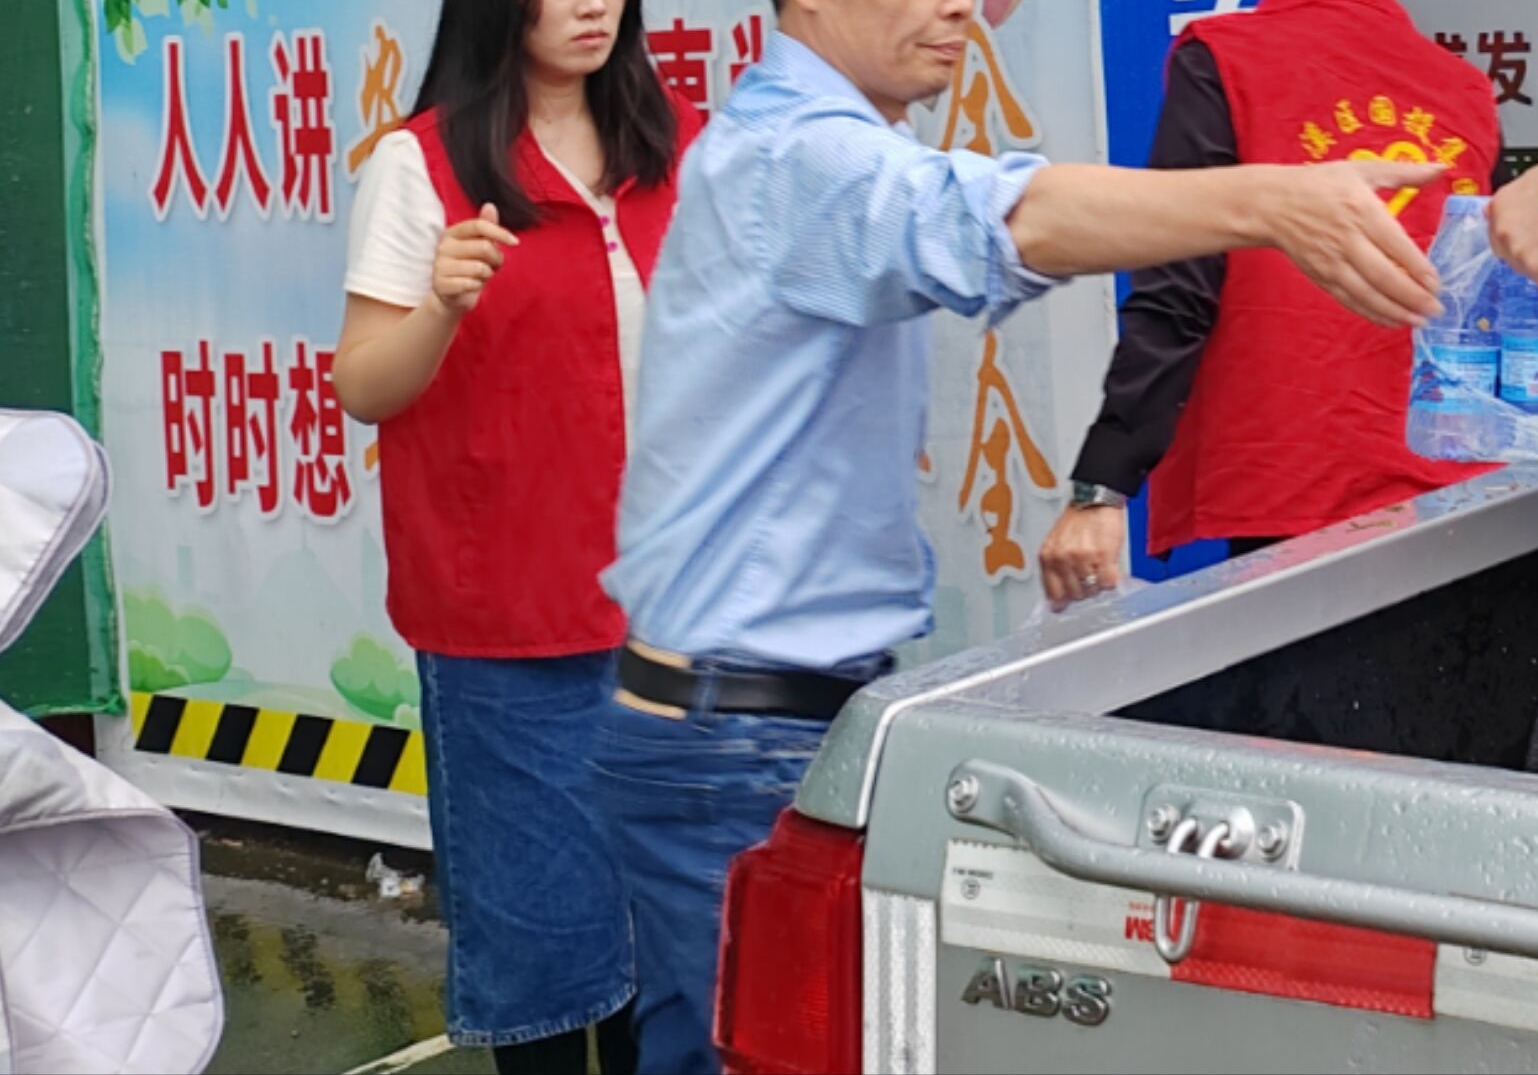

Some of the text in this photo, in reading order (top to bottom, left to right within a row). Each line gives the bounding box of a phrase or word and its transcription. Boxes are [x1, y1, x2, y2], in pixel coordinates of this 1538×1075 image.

[160, 340, 352, 518] 时时想
[960, 956, 1113, 1028] ABS
